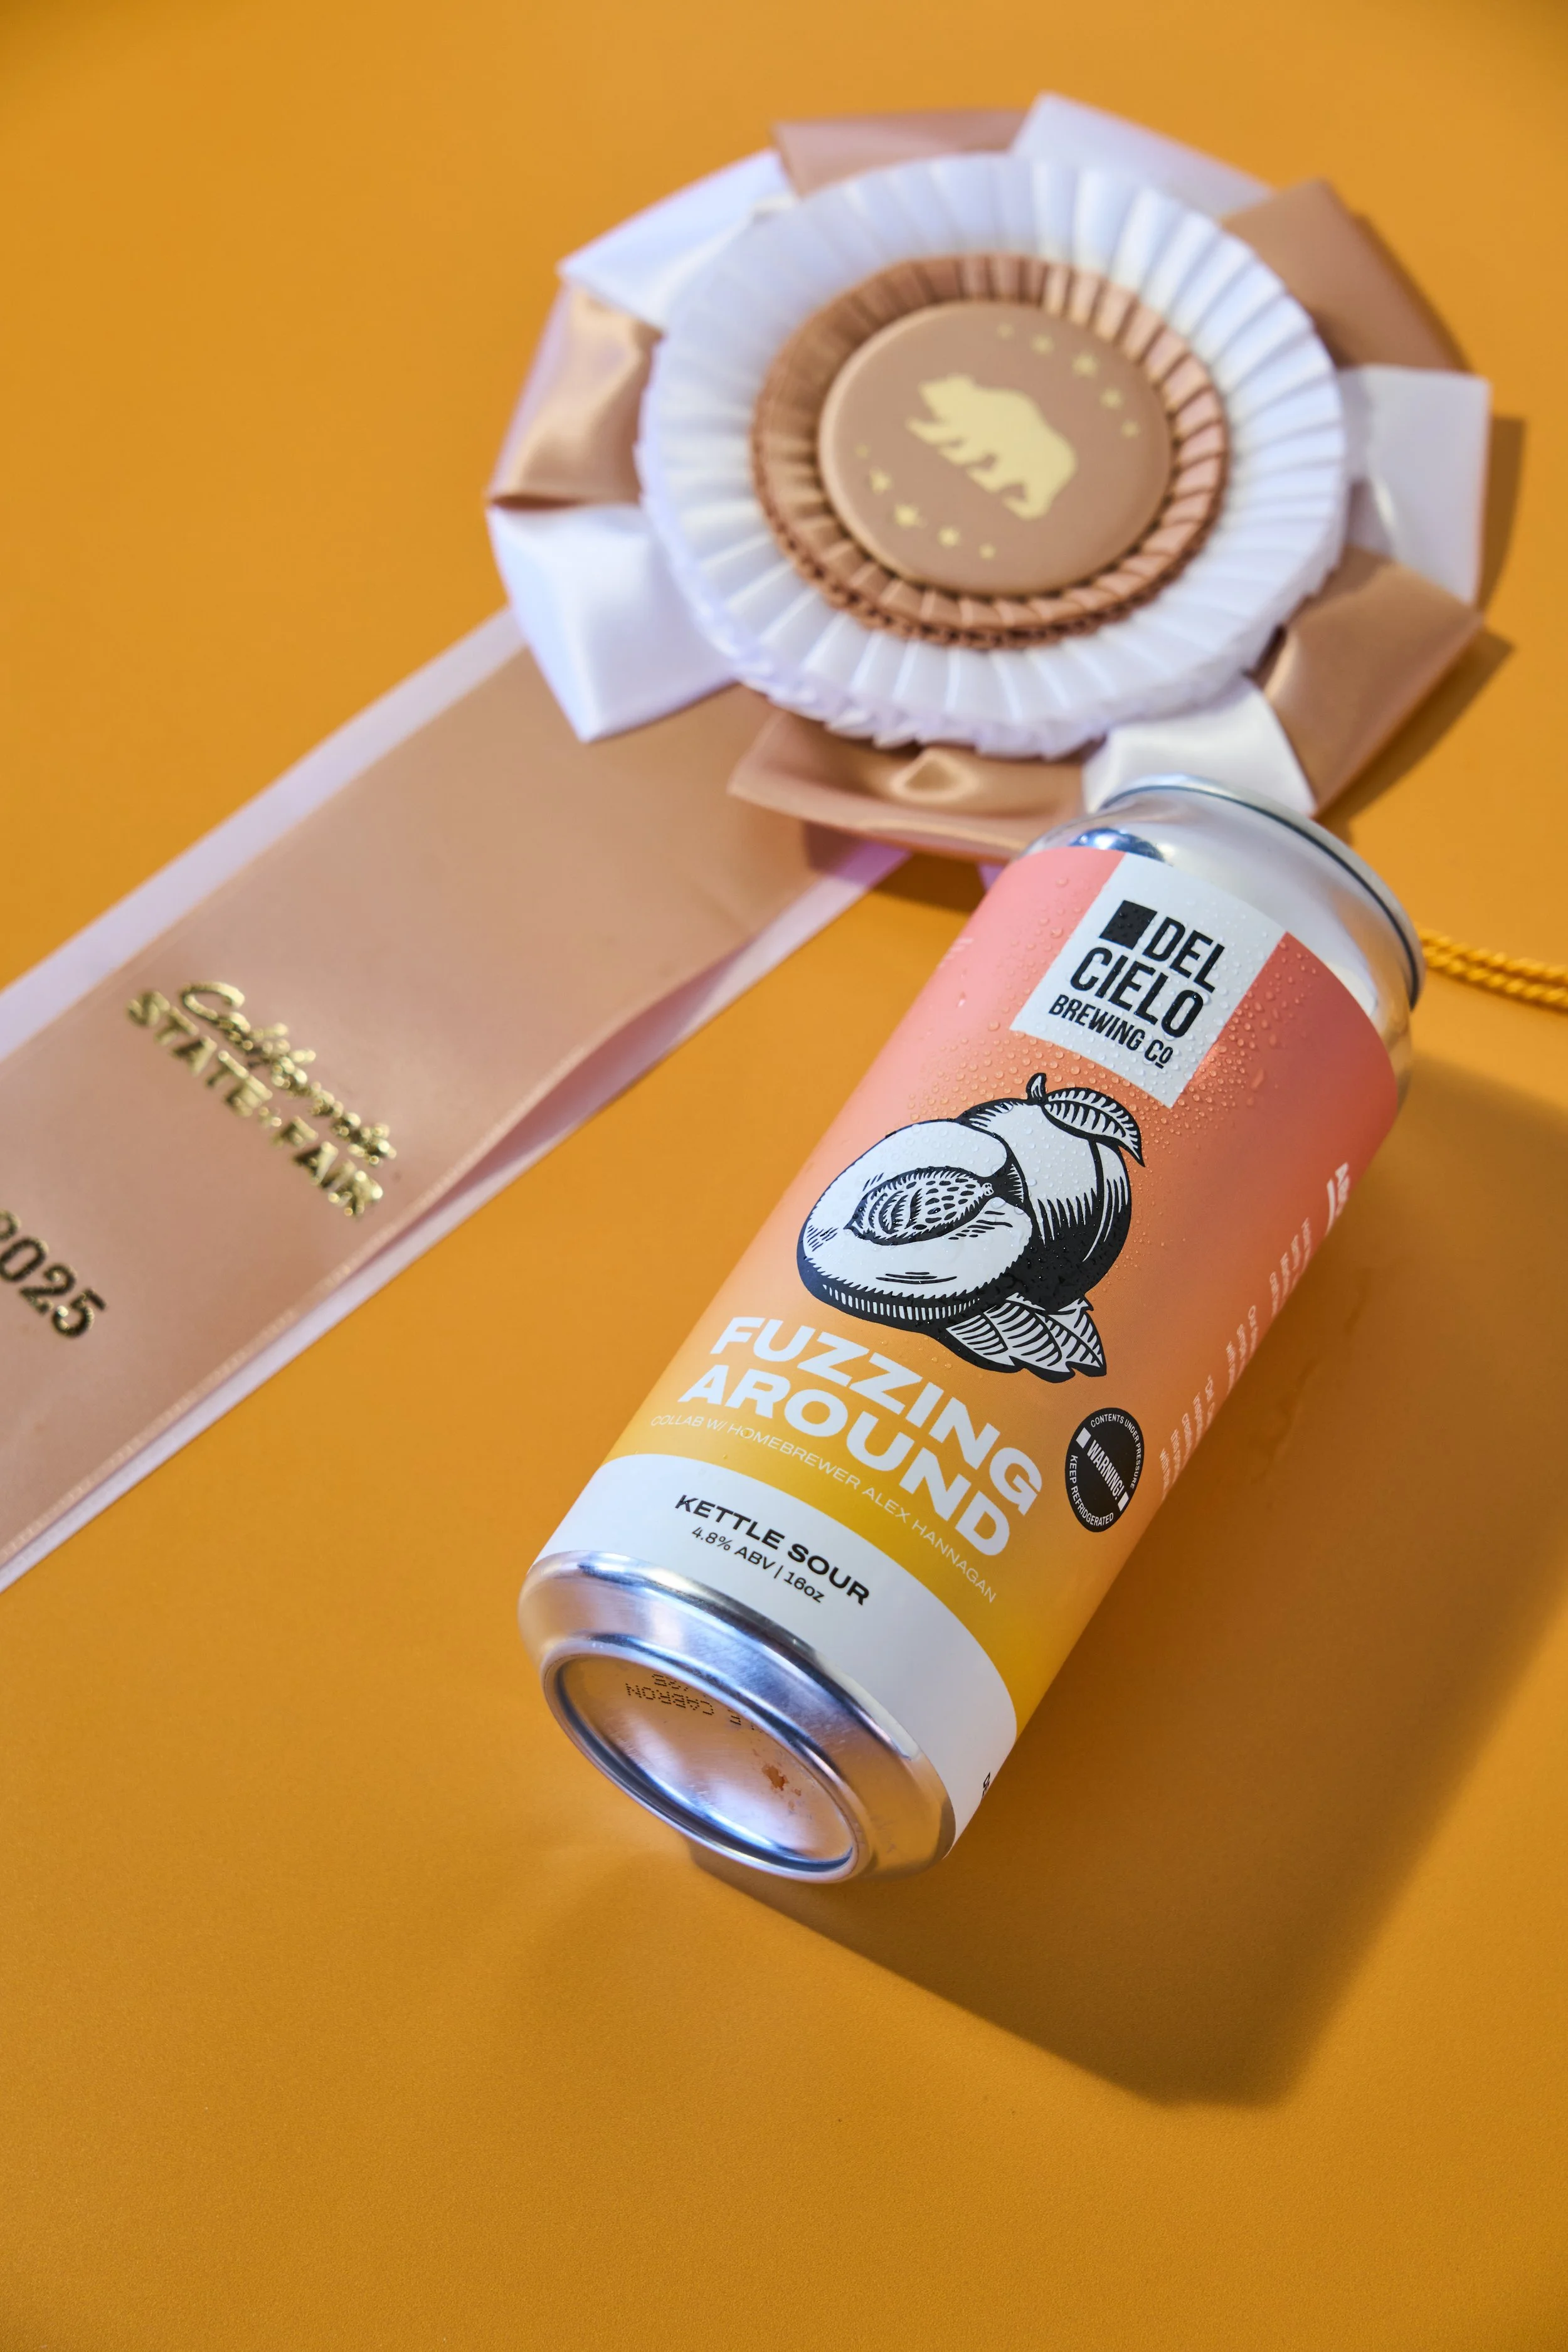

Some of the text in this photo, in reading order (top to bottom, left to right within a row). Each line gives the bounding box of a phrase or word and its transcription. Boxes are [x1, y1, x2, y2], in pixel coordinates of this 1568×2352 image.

[1070, 947, 1204, 1038] CIELO
[1143, 917, 1225, 993] DEL
[127, 989, 273, 1117] STATE
[1049, 995, 1145, 1051] BREWING
[710, 1316, 1042, 1517] FUZZING
[1090, 1413, 1142, 1489] CONTENTS UNDER PRESSURE
[678, 1364, 1010, 1556] AROUND
[1069, 1454, 1114, 1527] KEEP REFRIDGERATED
[1087, 1439, 1125, 1500] WARNING!
[651, 1415, 996, 1603] COLLAB W/ HOMEBREWER ALEX HANNAGAN
[674, 1495, 869, 1606] KETTLE SOUR
[692, 1527, 733, 1551] 4.8%
[734, 1546, 776, 1570] ABV
[784, 1571, 825, 1603] 16oz
